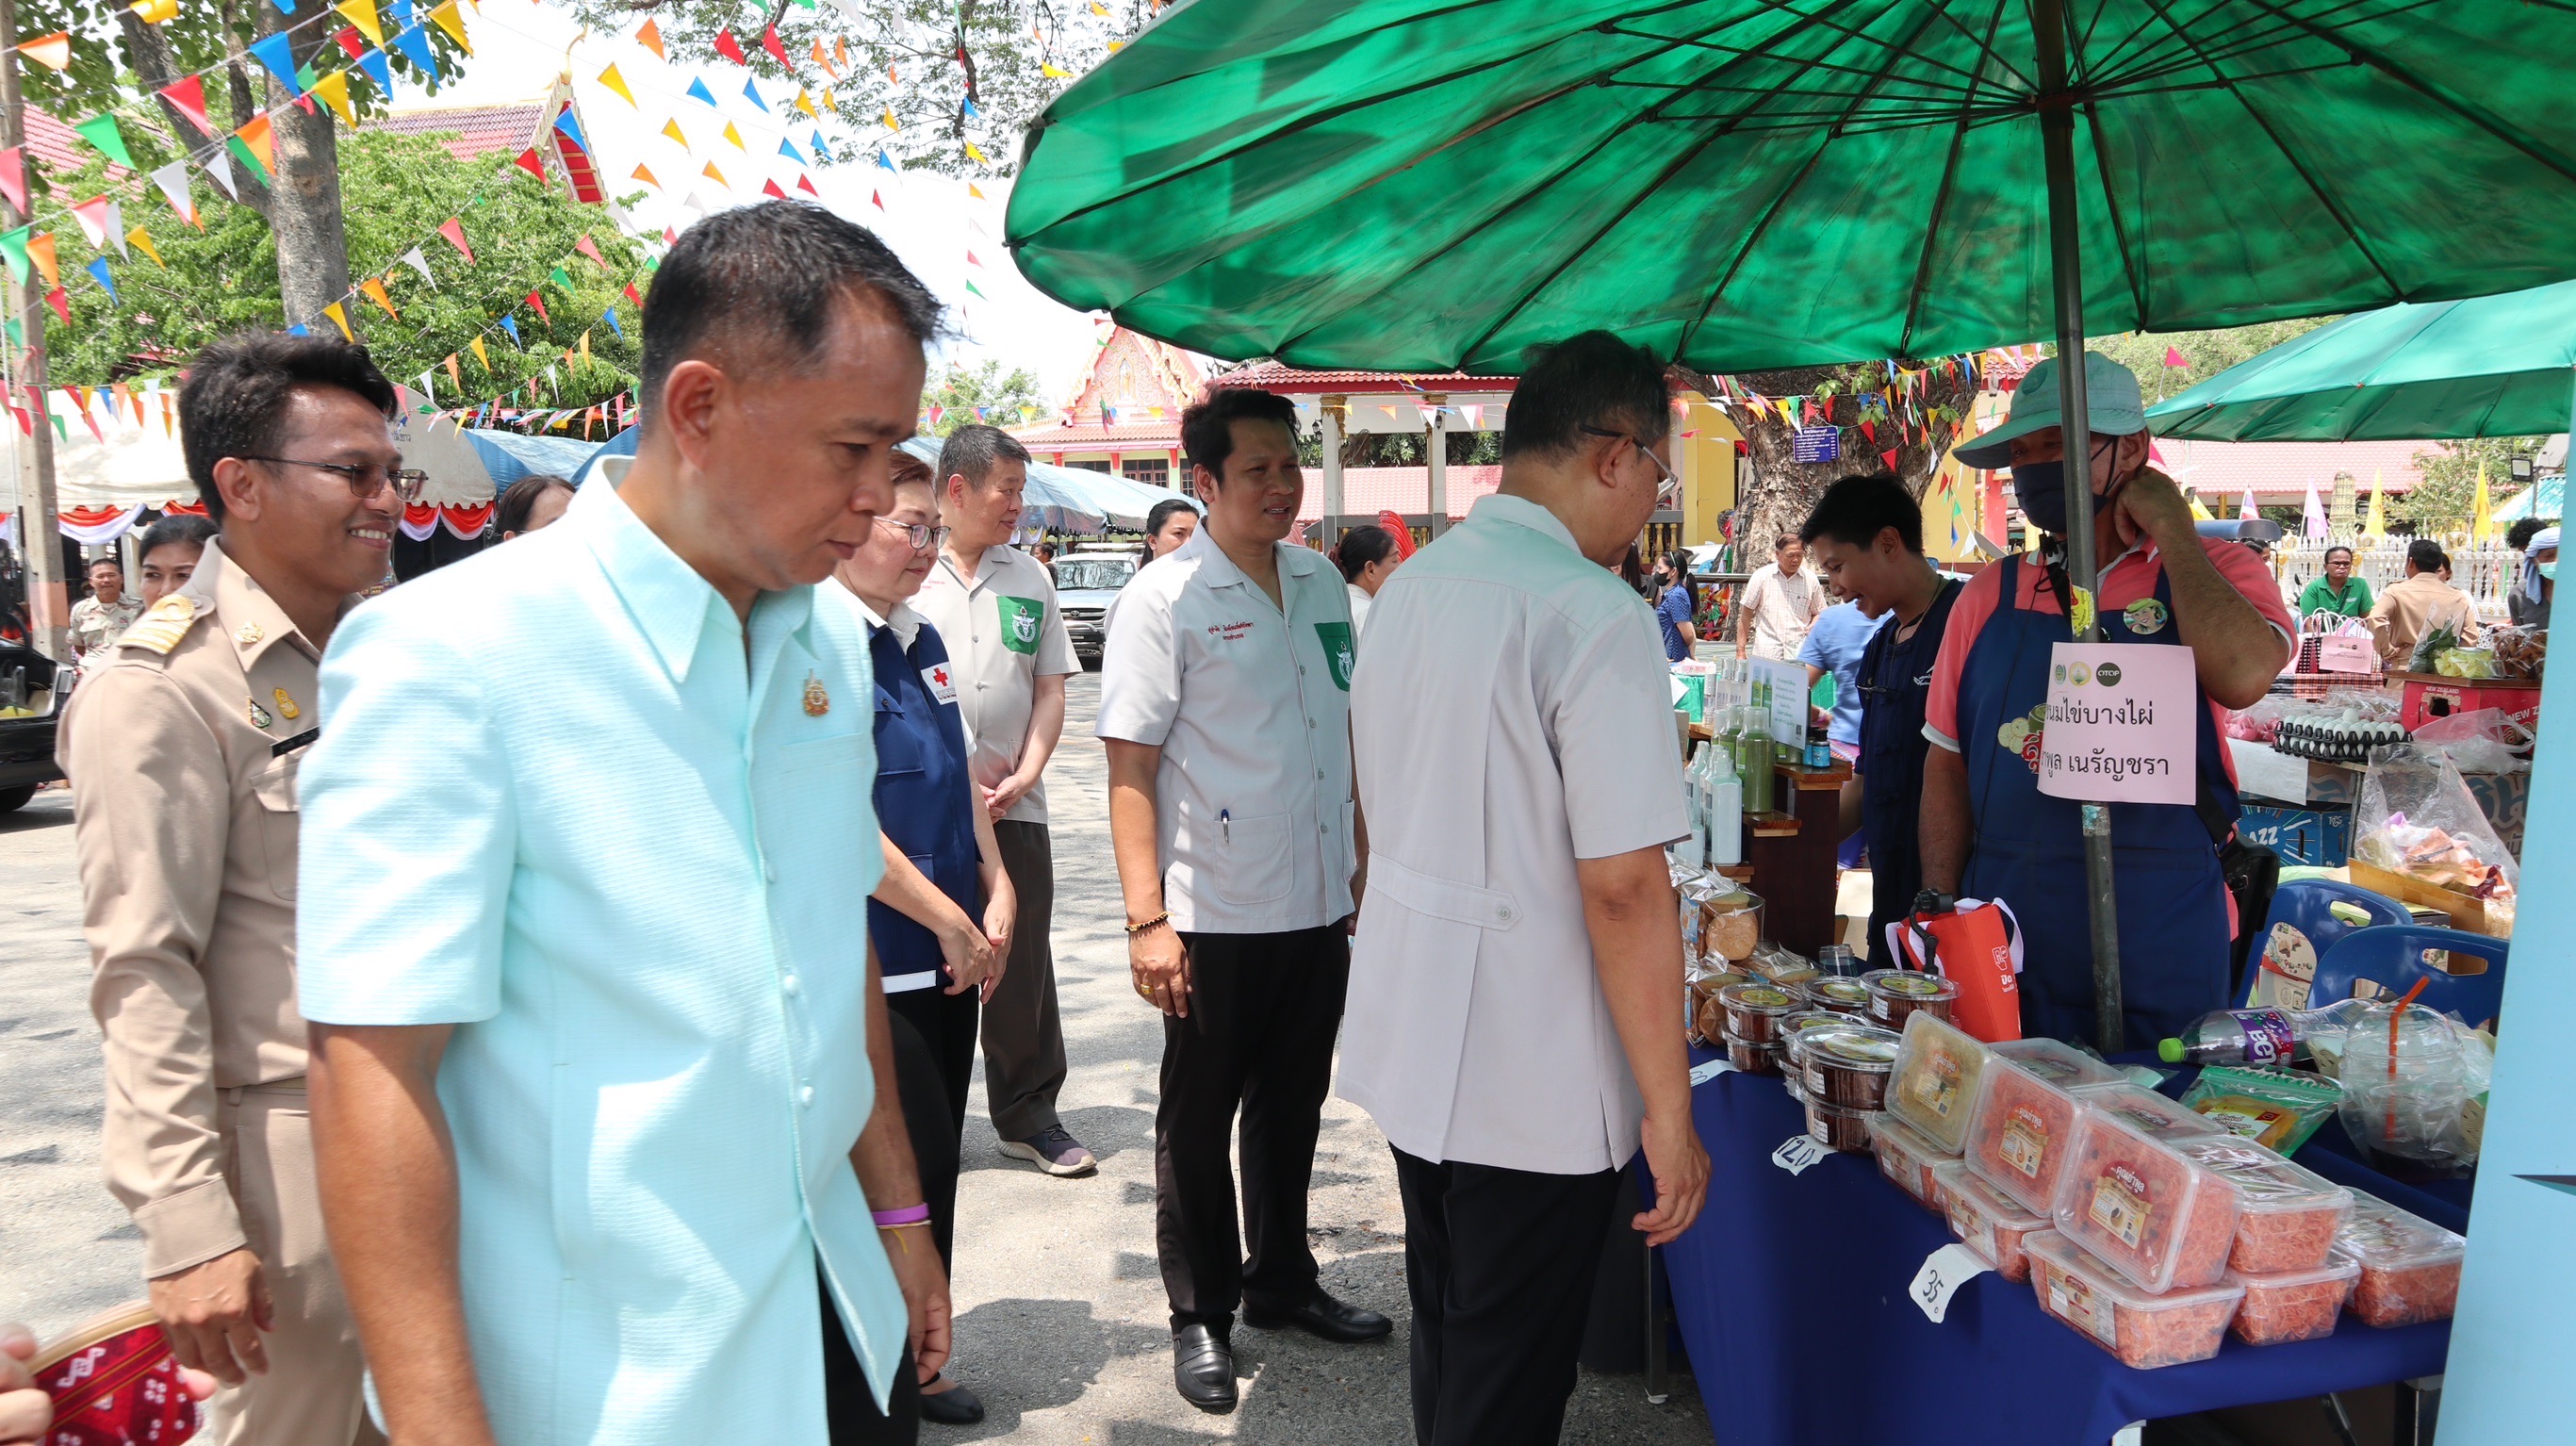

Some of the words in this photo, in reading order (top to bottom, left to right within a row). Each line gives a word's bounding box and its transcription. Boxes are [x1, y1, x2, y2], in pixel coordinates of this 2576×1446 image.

[2437, 686, 2460, 695] ZEALAND
[2508, 708, 2530, 721] NEW
[2041, 750, 2062, 779] าพูล
[2069, 748, 2169, 782] เนรัญชรา
[2249, 826, 2278, 846] AZZ
